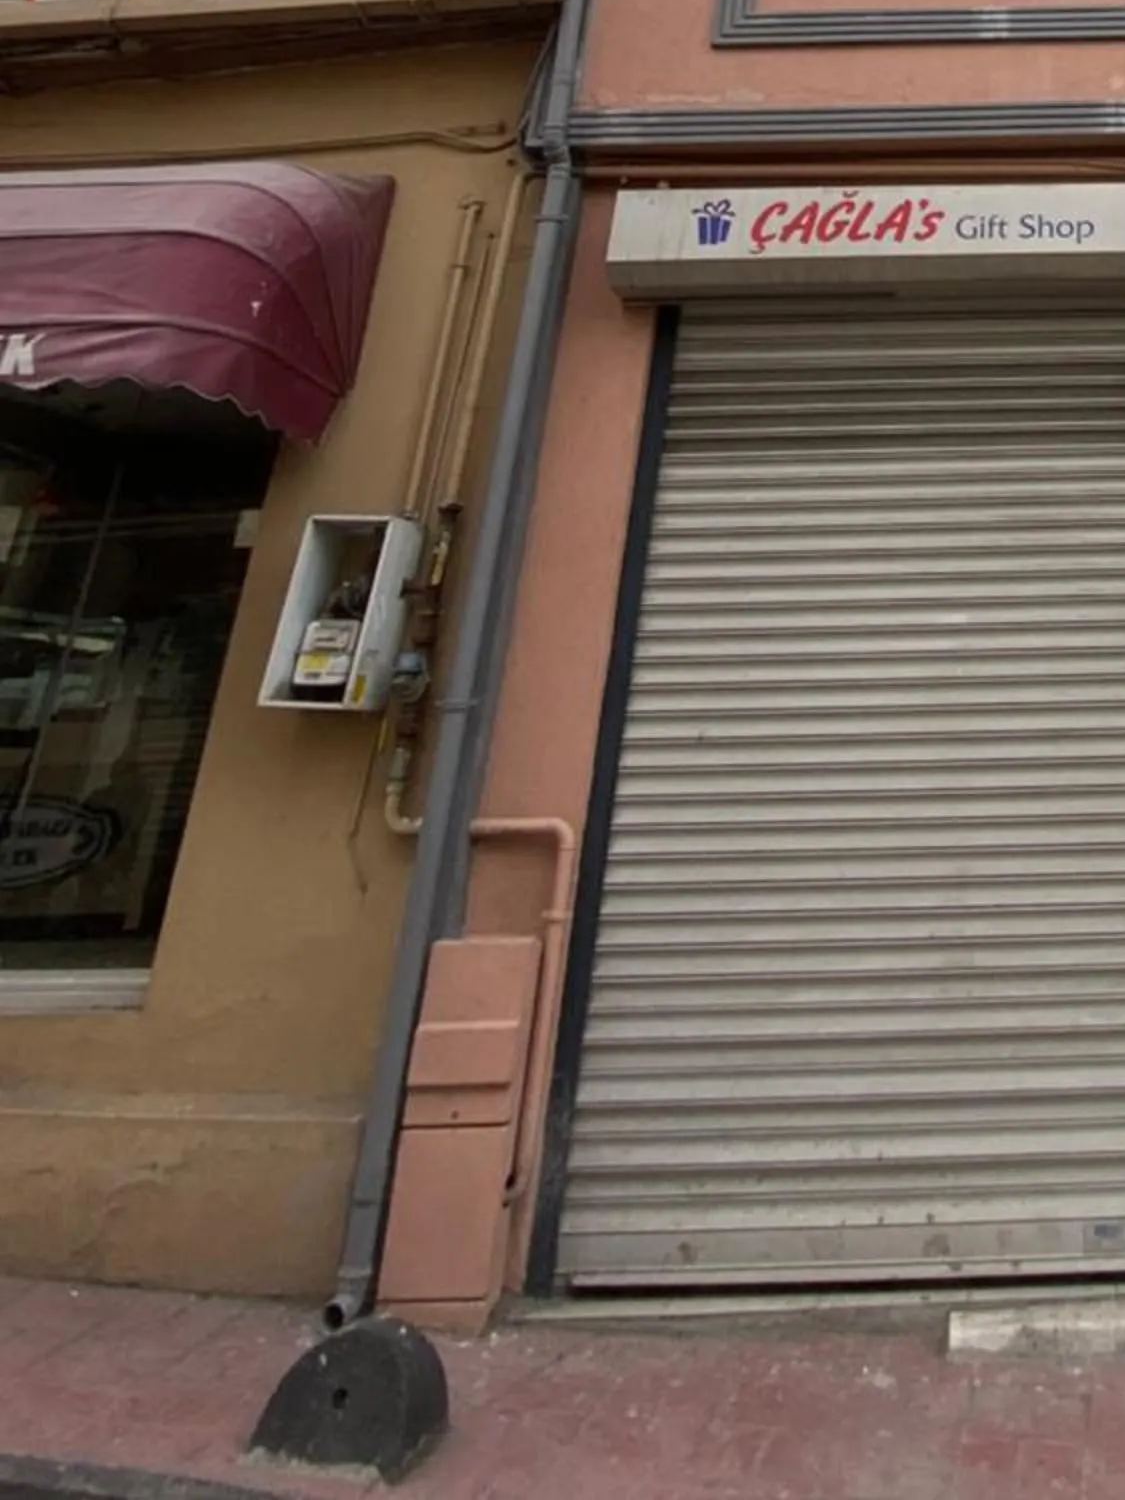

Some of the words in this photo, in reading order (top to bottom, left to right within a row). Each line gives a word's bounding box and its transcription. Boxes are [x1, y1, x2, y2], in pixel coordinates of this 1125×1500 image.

[750, 190, 945, 255] ÇAĞLA's
[955, 215, 1008, 240] Gift
[1018, 213, 1095, 244] Shop
